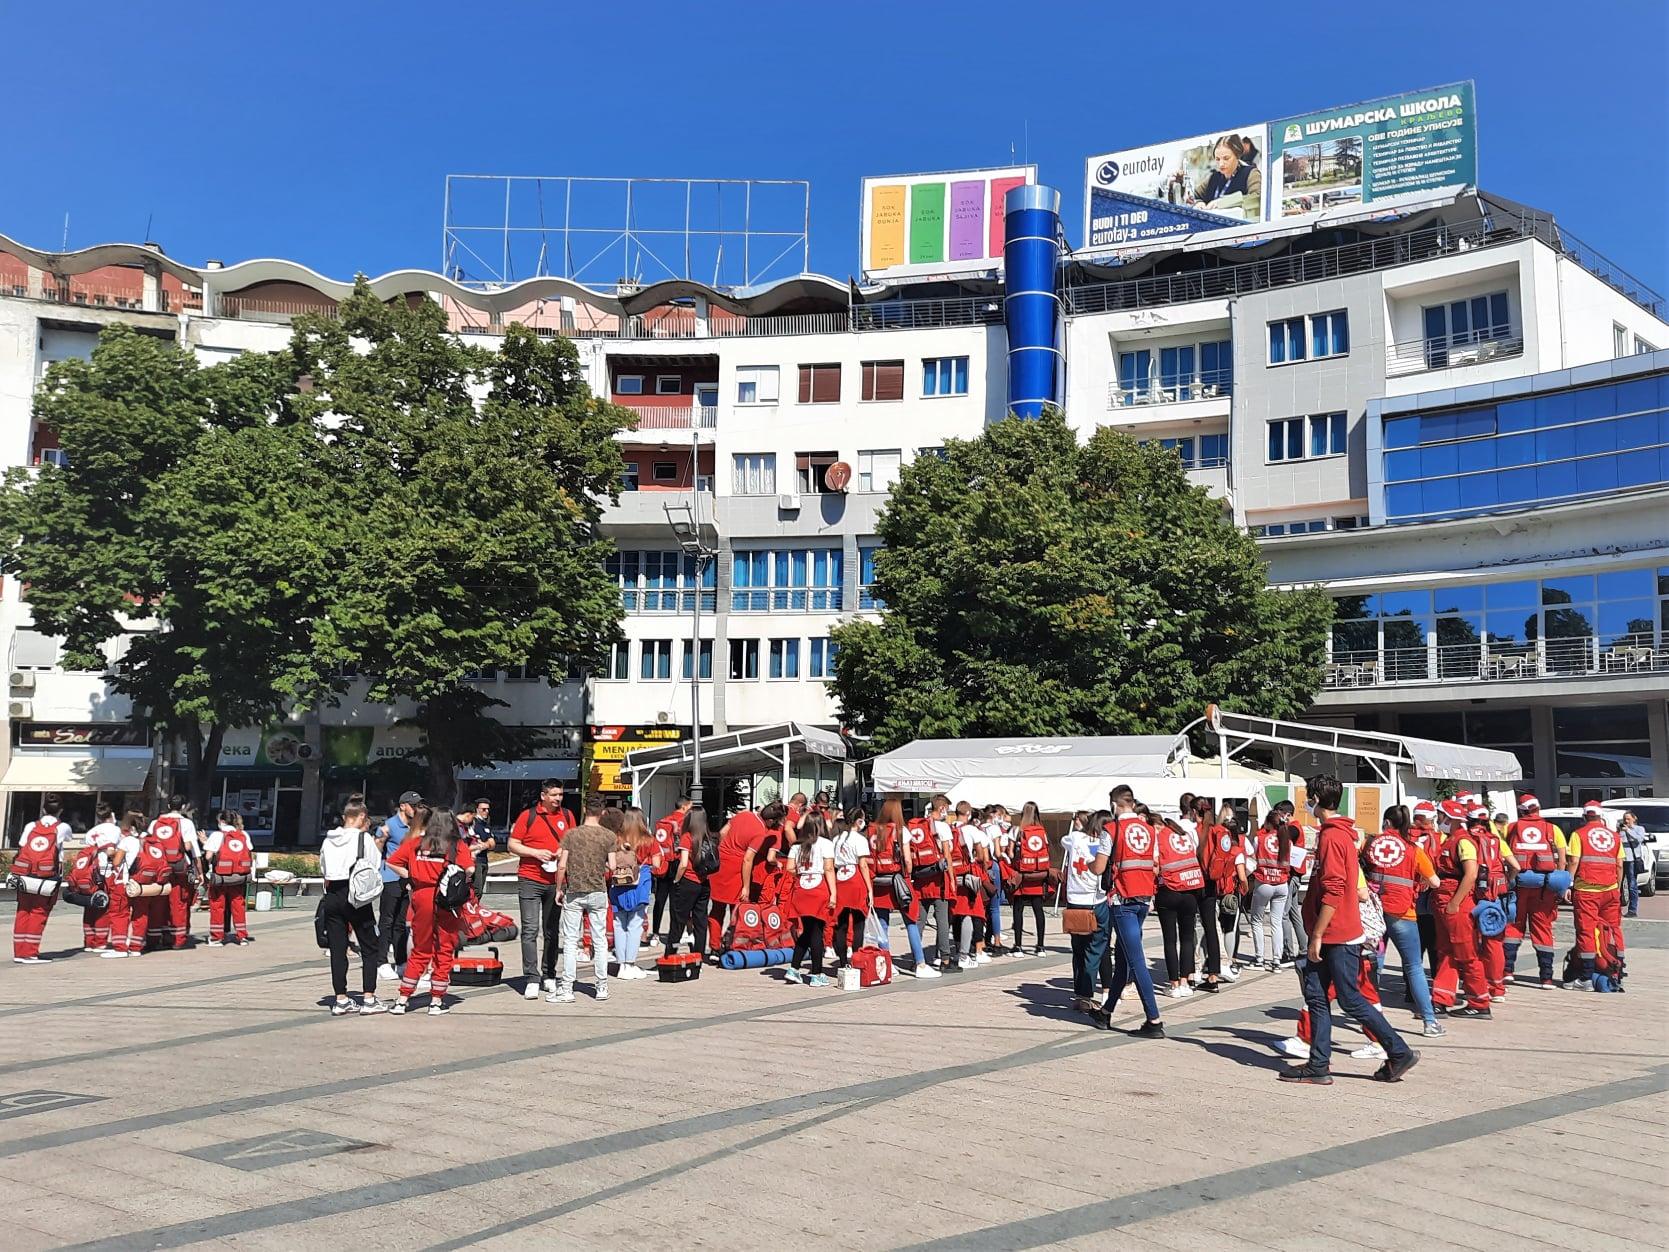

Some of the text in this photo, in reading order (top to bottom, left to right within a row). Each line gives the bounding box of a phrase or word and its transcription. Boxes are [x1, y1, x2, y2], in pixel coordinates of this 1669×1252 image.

[1305, 95, 1462, 135] ШУМАРСКА ШКОЛА
[1401, 108, 1463, 125] КРАЉЕВО
[1387, 125, 1422, 139] ГОДИНЕ
[1122, 155, 1165, 176] eurotay
[1092, 210, 1148, 231] BUDI I TI DEO
[1092, 222, 1190, 245] eurotay-a 036/203-221
